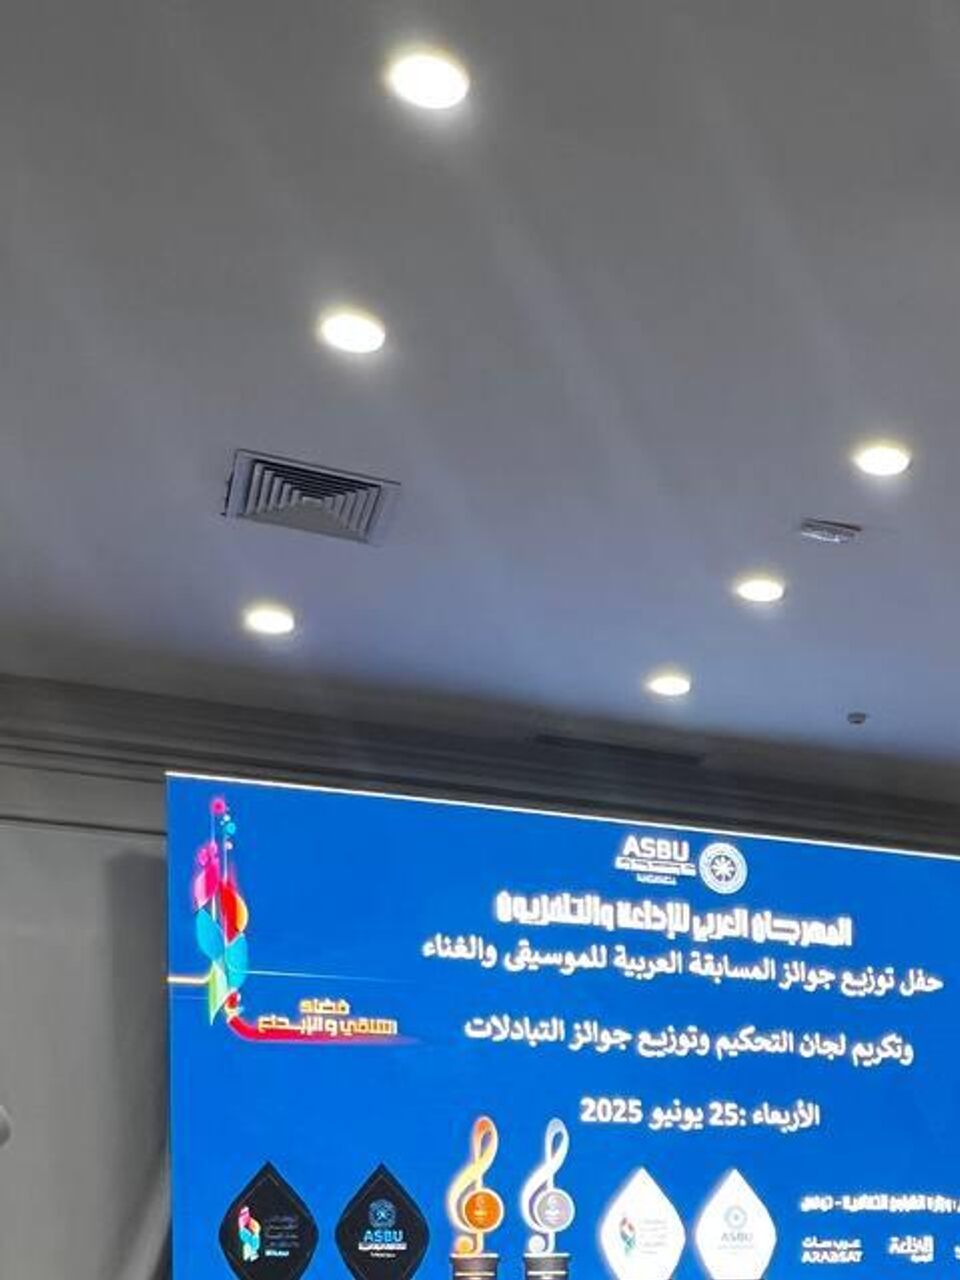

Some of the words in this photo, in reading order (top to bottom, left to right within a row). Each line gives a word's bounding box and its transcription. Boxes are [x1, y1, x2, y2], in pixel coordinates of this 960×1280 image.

[622, 834, 690, 862] ASBU
[495, 890, 615, 931] والتلفزيون
[692, 907, 750, 942] العربي
[752, 910, 853, 947] المهرجان
[422, 934, 498, 968] والغناء
[502, 939, 608, 975] للموسيقى
[612, 945, 683, 979] العربية
[687, 951, 777, 983] المسابقة
[778, 961, 837, 992] جوائز
[838, 967, 897, 996] توزيع
[898, 969, 943, 996] حفل
[464, 1015, 565, 1046] التبادلات
[568, 1021, 633, 1052] جوائز
[635, 1026, 711, 1057] وتوزيع
[713, 1026, 795, 1060] التحكيم
[797, 1033, 847, 1060] لجان
[850, 1033, 914, 1067] وتكريم
[580, 1097, 643, 1123] 2025
[648, 1099, 705, 1129] يونيو
[751, 1100, 820, 1133] الأربعاء
[364, 1231, 403, 1243] ASBU
